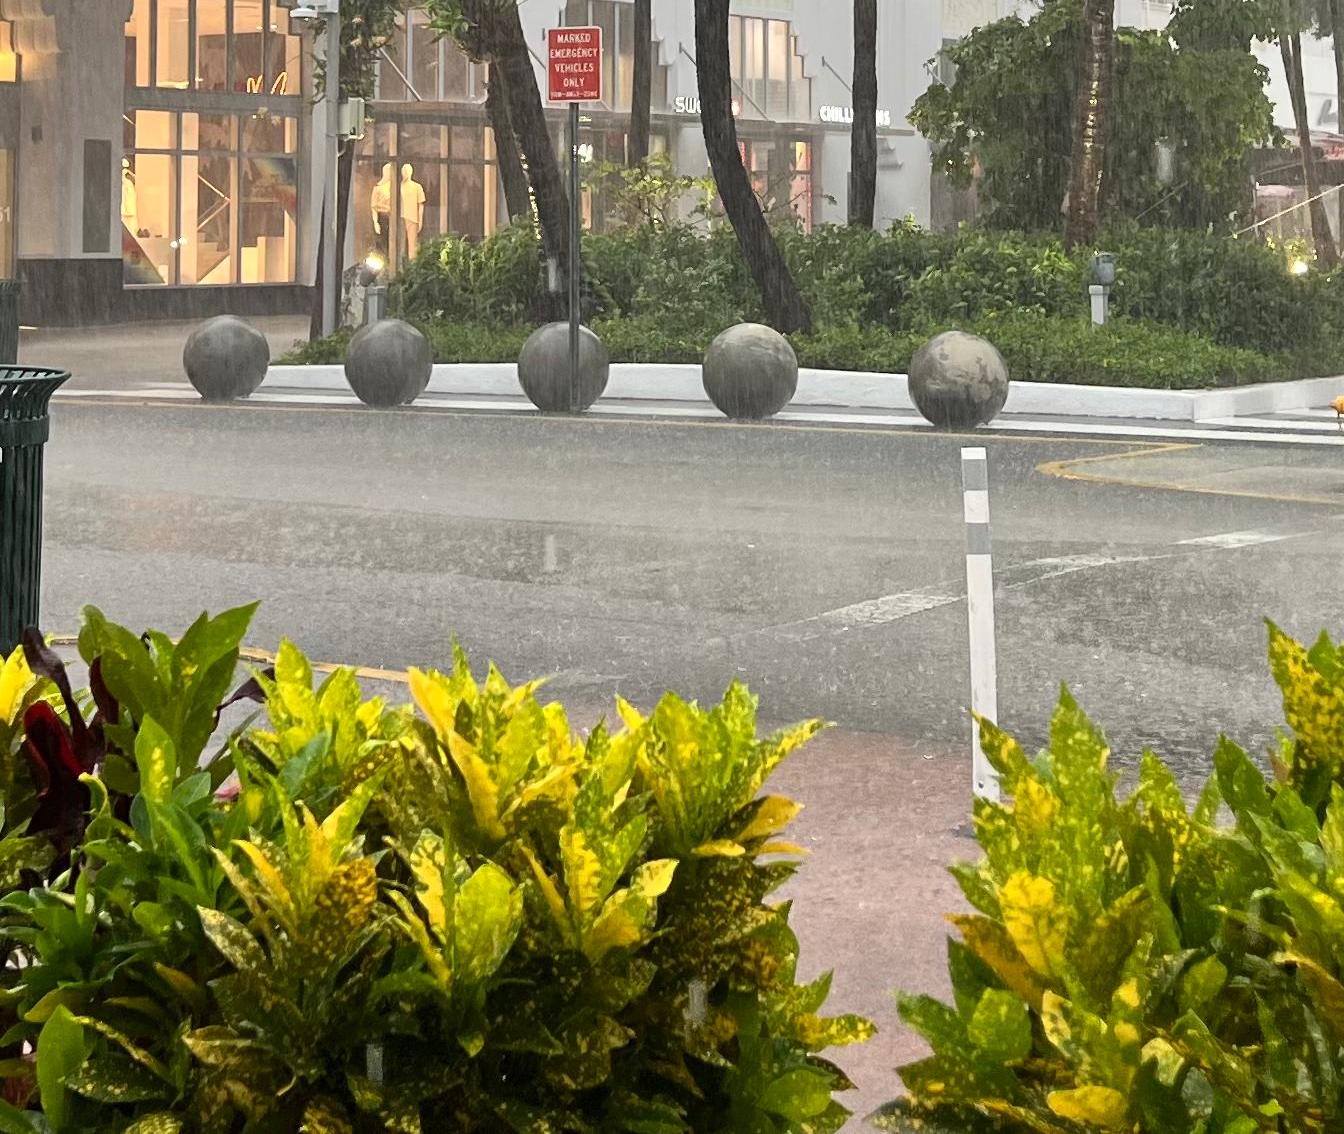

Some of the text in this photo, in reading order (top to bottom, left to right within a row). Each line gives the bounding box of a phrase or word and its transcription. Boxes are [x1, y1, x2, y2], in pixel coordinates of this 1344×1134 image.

[557, 33, 591, 44] MARKED
[550, 47, 598, 59] EMERGENCY
[554, 63, 594, 73] VEHICLES
[563, 77, 585, 88] ONLY
